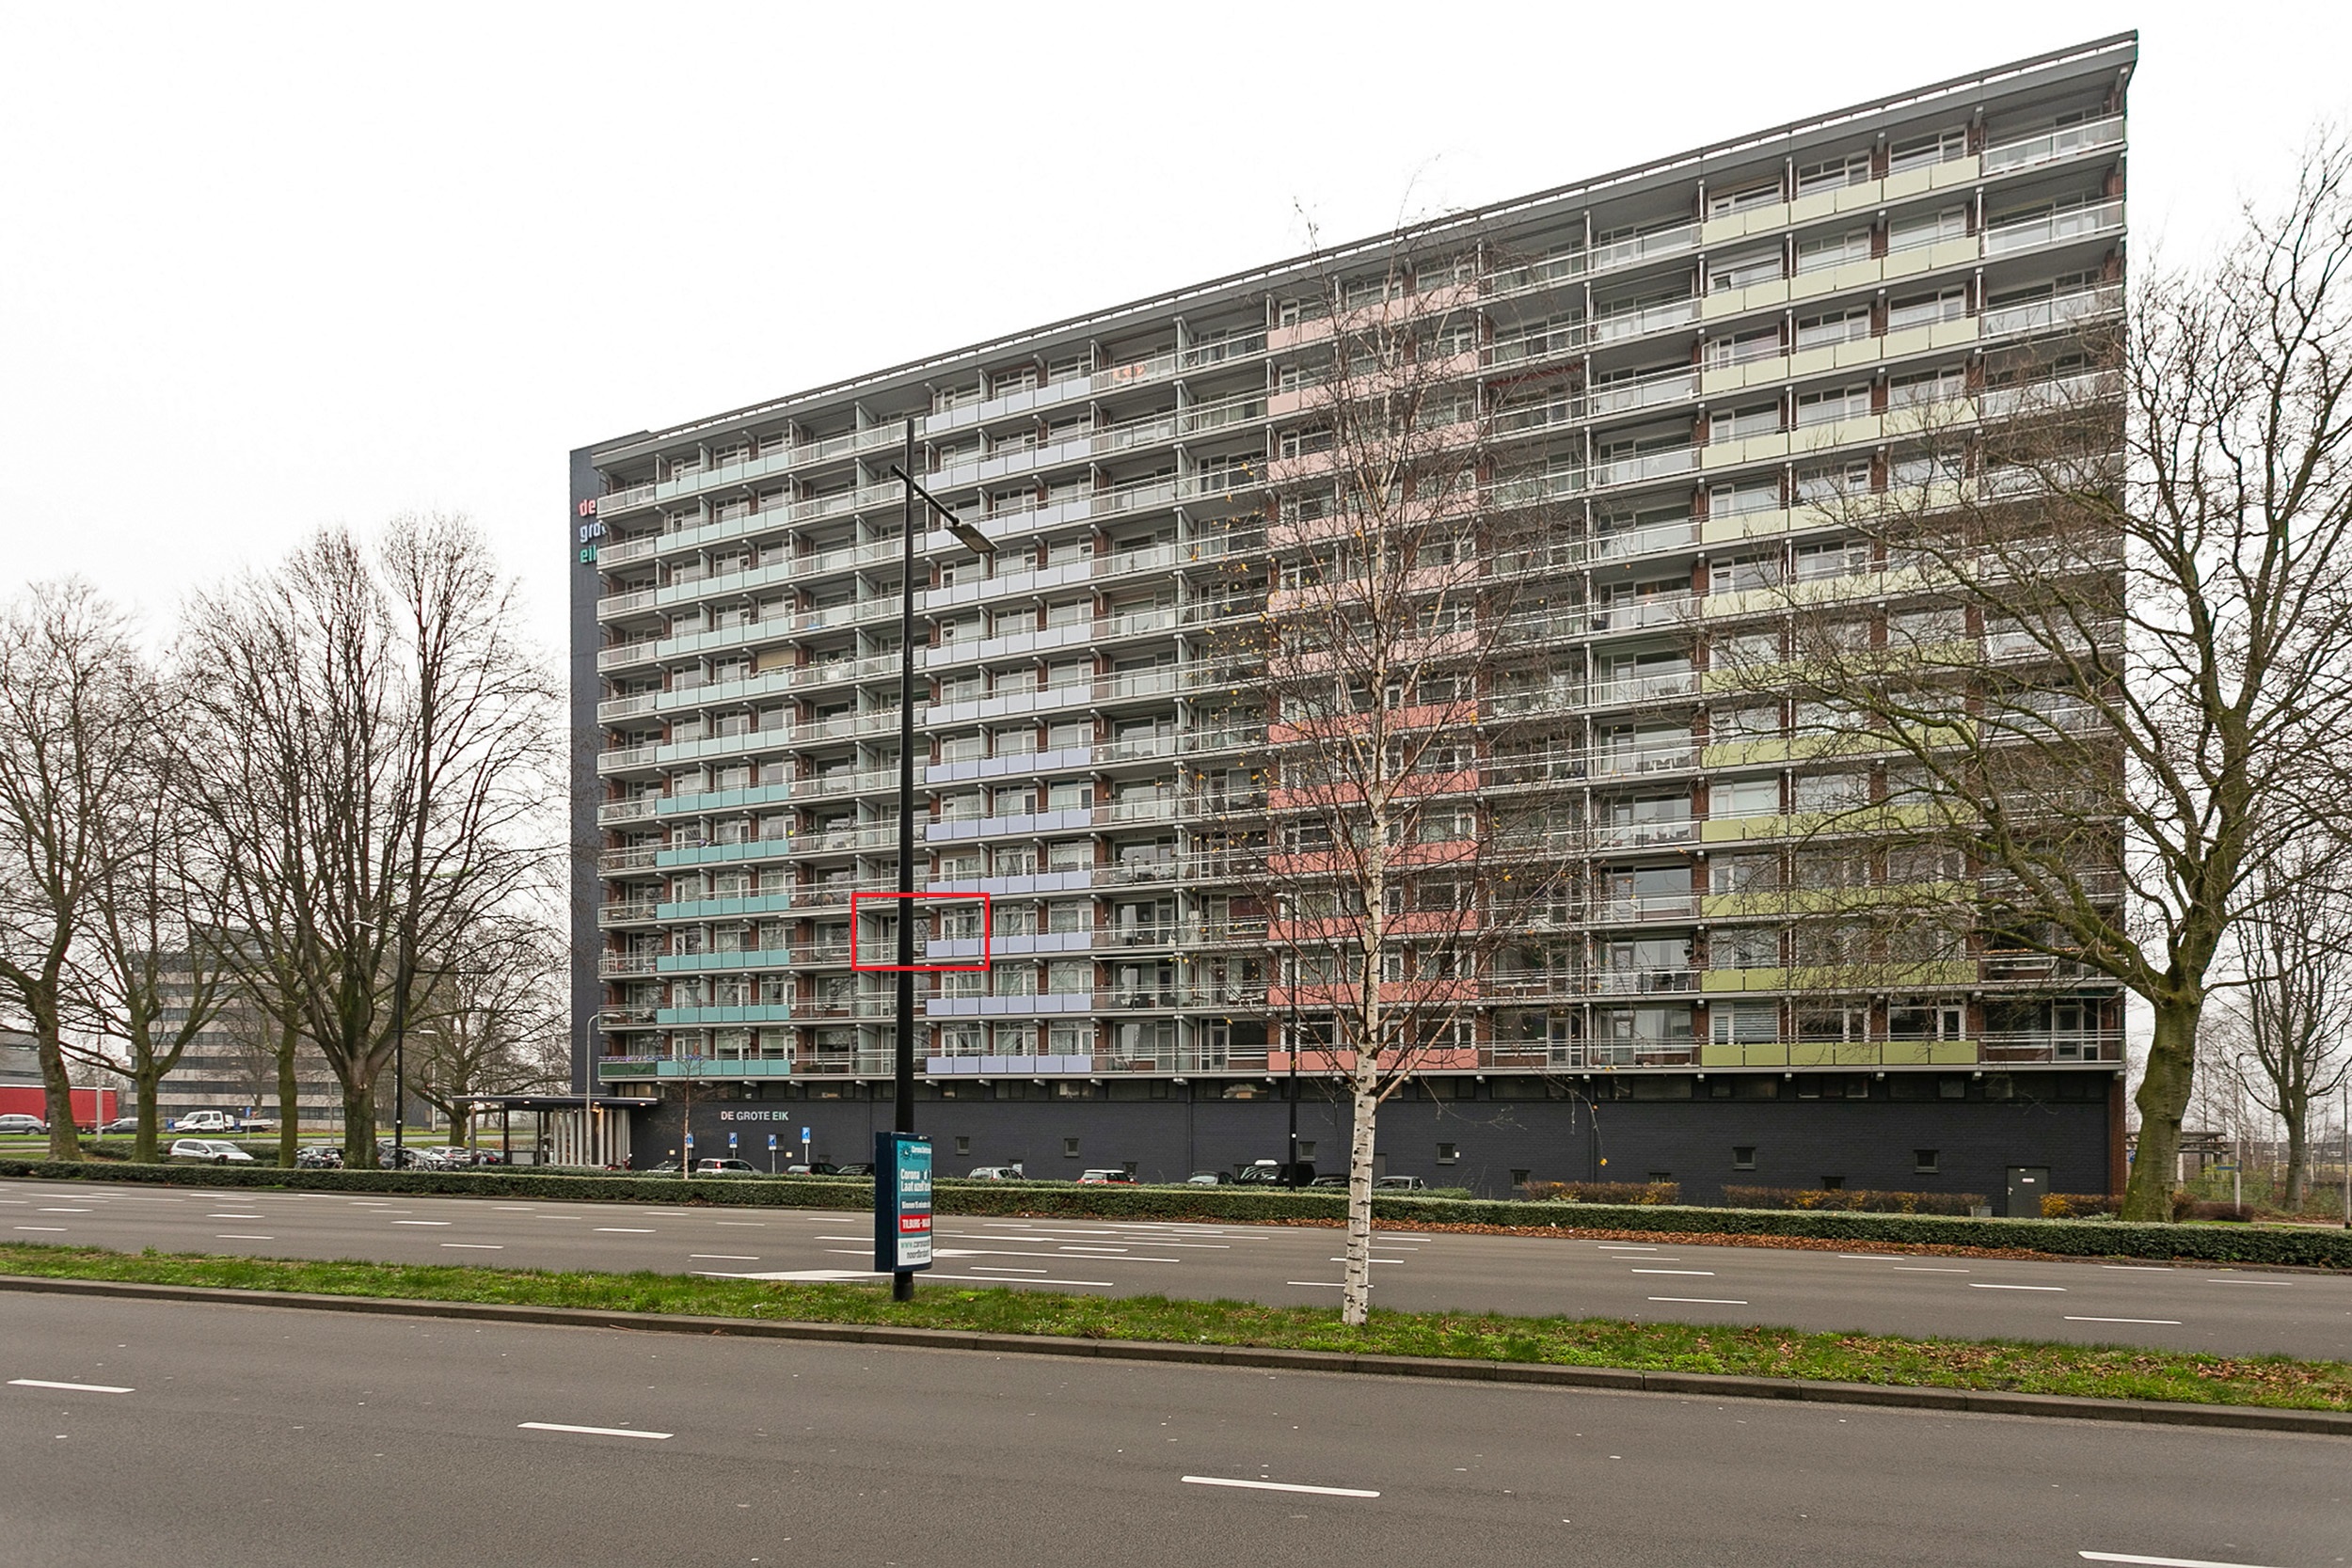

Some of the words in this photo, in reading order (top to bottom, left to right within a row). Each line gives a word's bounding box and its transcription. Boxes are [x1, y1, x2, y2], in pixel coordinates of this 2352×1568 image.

[579, 499, 596, 516] de
[721, 1111, 734, 1120] DE
[736, 1111, 771, 1121] GROTE
[772, 1111, 788, 1120] EIK
